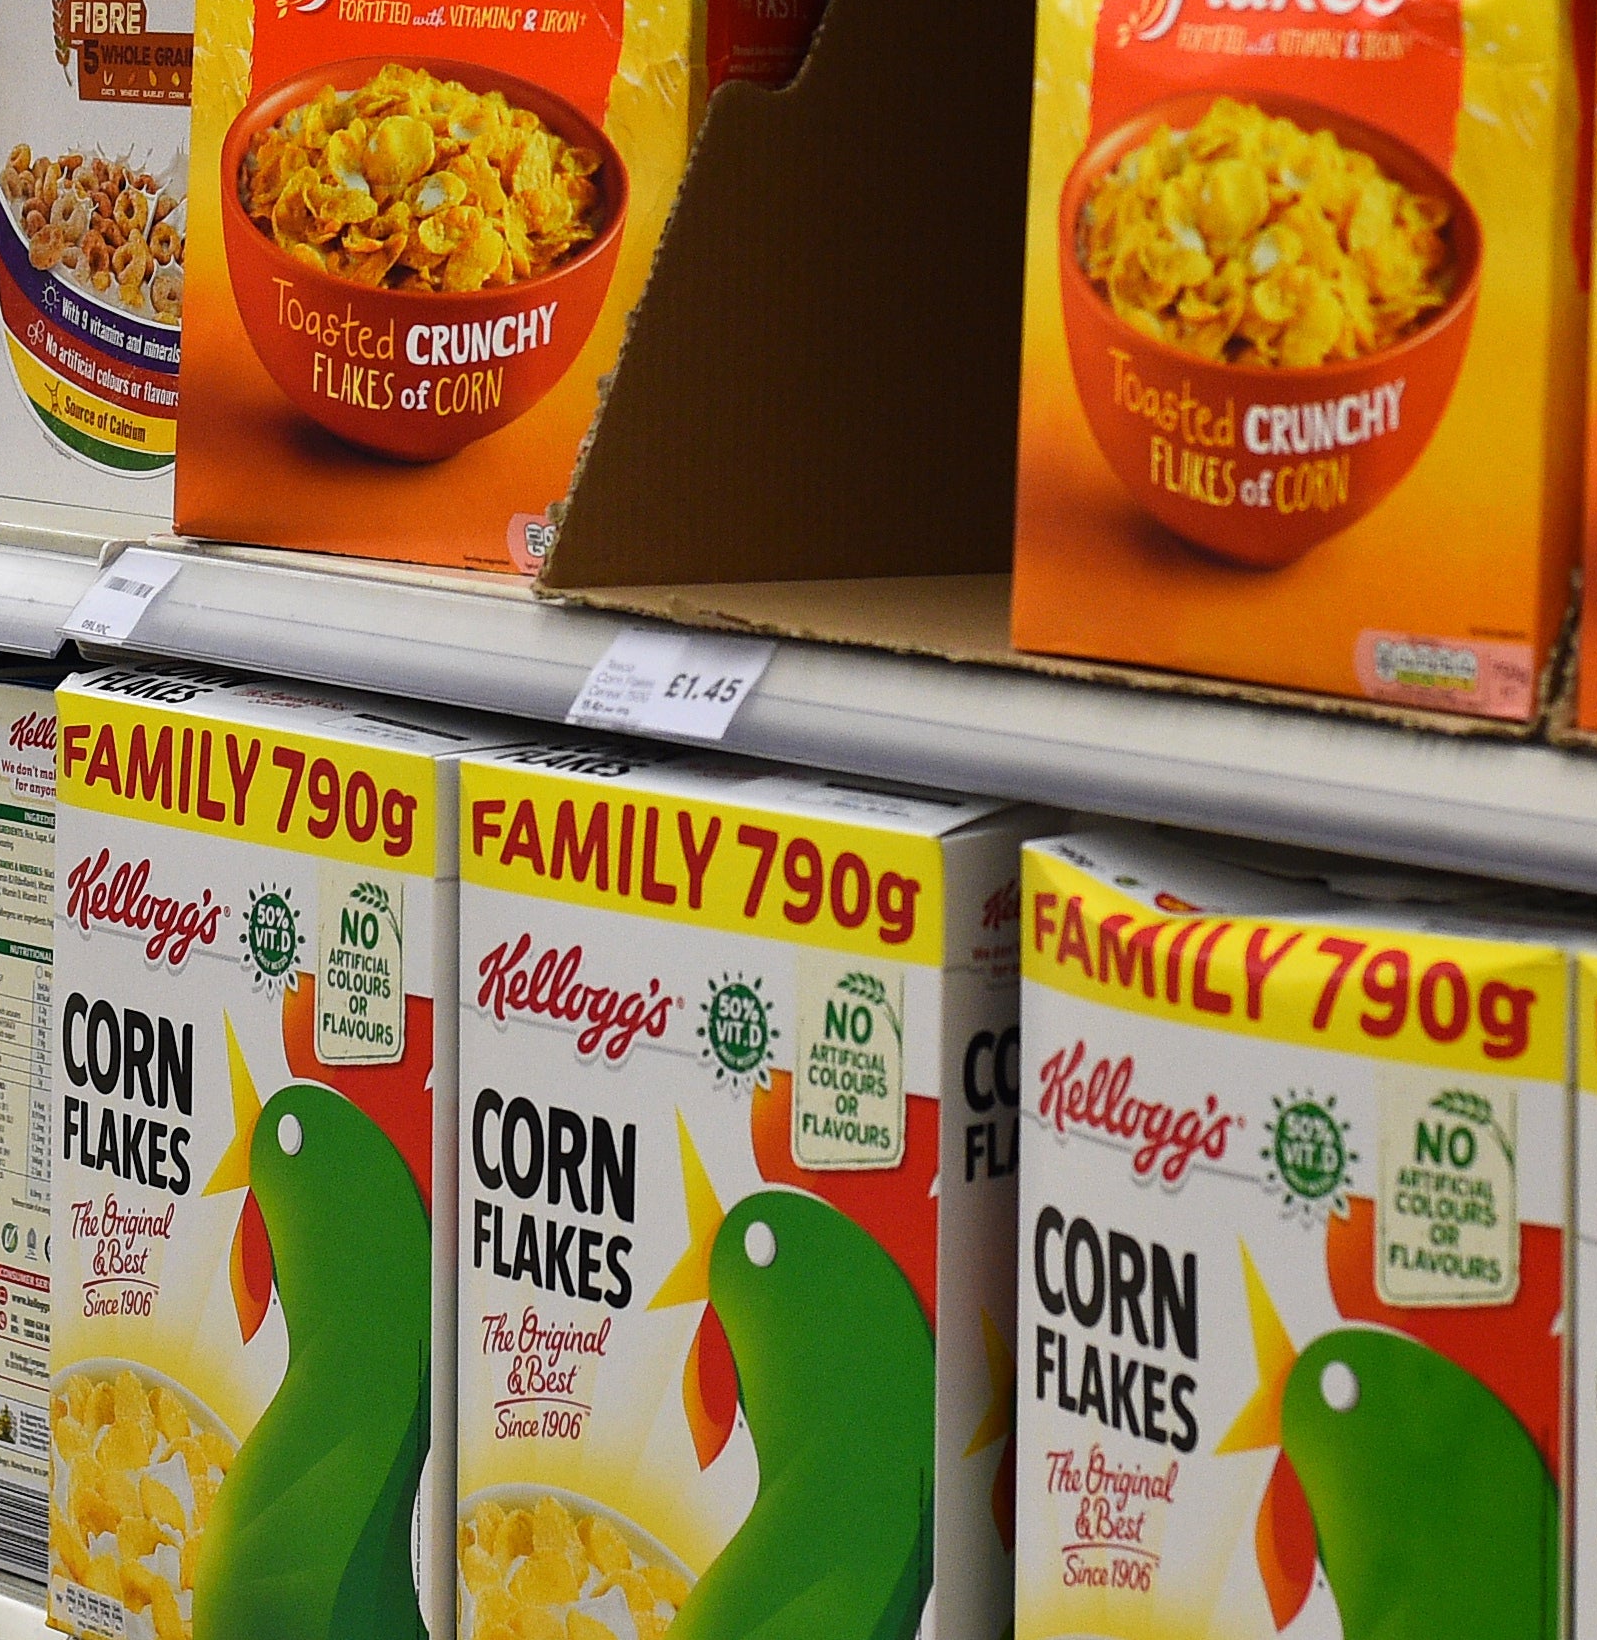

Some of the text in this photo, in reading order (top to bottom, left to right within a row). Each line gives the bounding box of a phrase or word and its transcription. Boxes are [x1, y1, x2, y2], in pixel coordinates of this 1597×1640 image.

[412, 5, 447, 28] with
[449, 3, 520, 32] VITAMINS
[523, 6, 537, 32] &
[62, 296, 181, 363] With 9 vitamins and minerals
[271, 277, 559, 367] Toasted CRUNCHY
[46, 332, 57, 357] No
[59, 346, 95, 382] artificial
[97, 369, 129, 395] colours
[131, 382, 141, 398] or
[312, 352, 504, 417] FLAKES of CORN
[65, 395, 145, 442] Source of Calcium
[1243, 377, 1406, 456] CRUNCHY
[664, 673, 744, 705] £1.45
[1, 759, 38, 778] We don't
[62, 723, 418, 857] FAMILY 790g
[471, 798, 922, 945] FAMILY 790g
[67, 848, 219, 965] Kellogg's
[340, 908, 380, 949] NO
[327, 970, 392, 1001] COLOURS
[328, 949, 392, 978] ARTIFICIAL
[1033, 890, 1537, 1061] FAMILY 790g
[322, 1012, 394, 1047] FLAVOURS
[349, 995, 368, 1015] OR
[477, 932, 674, 1062] Kellogg's
[62, 992, 194, 1117] CORN
[62, 1096, 191, 1197] FLAKES
[471, 1088, 637, 1224] CORN
[71, 1193, 176, 1250] The Original
[473, 1198, 634, 1310] FLAKES
[83, 1289, 152, 1318] Since 1906
